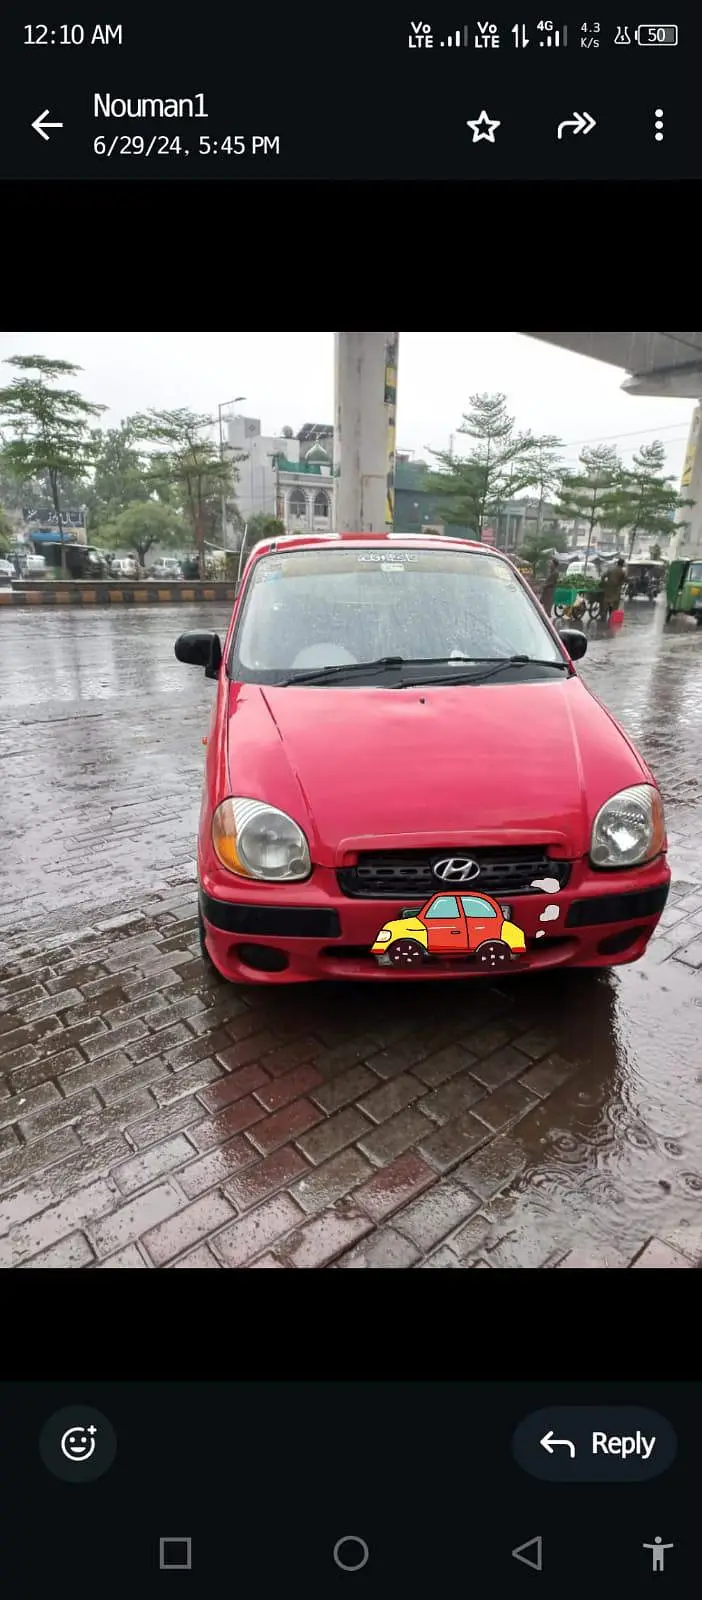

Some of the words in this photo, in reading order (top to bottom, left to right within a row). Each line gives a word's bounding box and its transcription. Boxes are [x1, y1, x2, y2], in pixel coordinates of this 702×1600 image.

[410, 21, 432, 34] Vo
[476, 21, 498, 34] Vo
[536, 20, 554, 32] 4G
[580, 22, 601, 33] 4.3
[23, 23, 85, 45] 12:10
[90, 23, 123, 45] AM
[647, 28, 666, 42] 50
[408, 35, 434, 49] LTE
[474, 35, 500, 49] LTE
[580, 36, 600, 49] K/s
[94, 92, 209, 118] Nouman1
[93, 135, 190, 157] 6/29/24,
[198, 135, 246, 157] 5:45
[251, 135, 280, 157] PM
[592, 1430, 657, 1460] Reply
